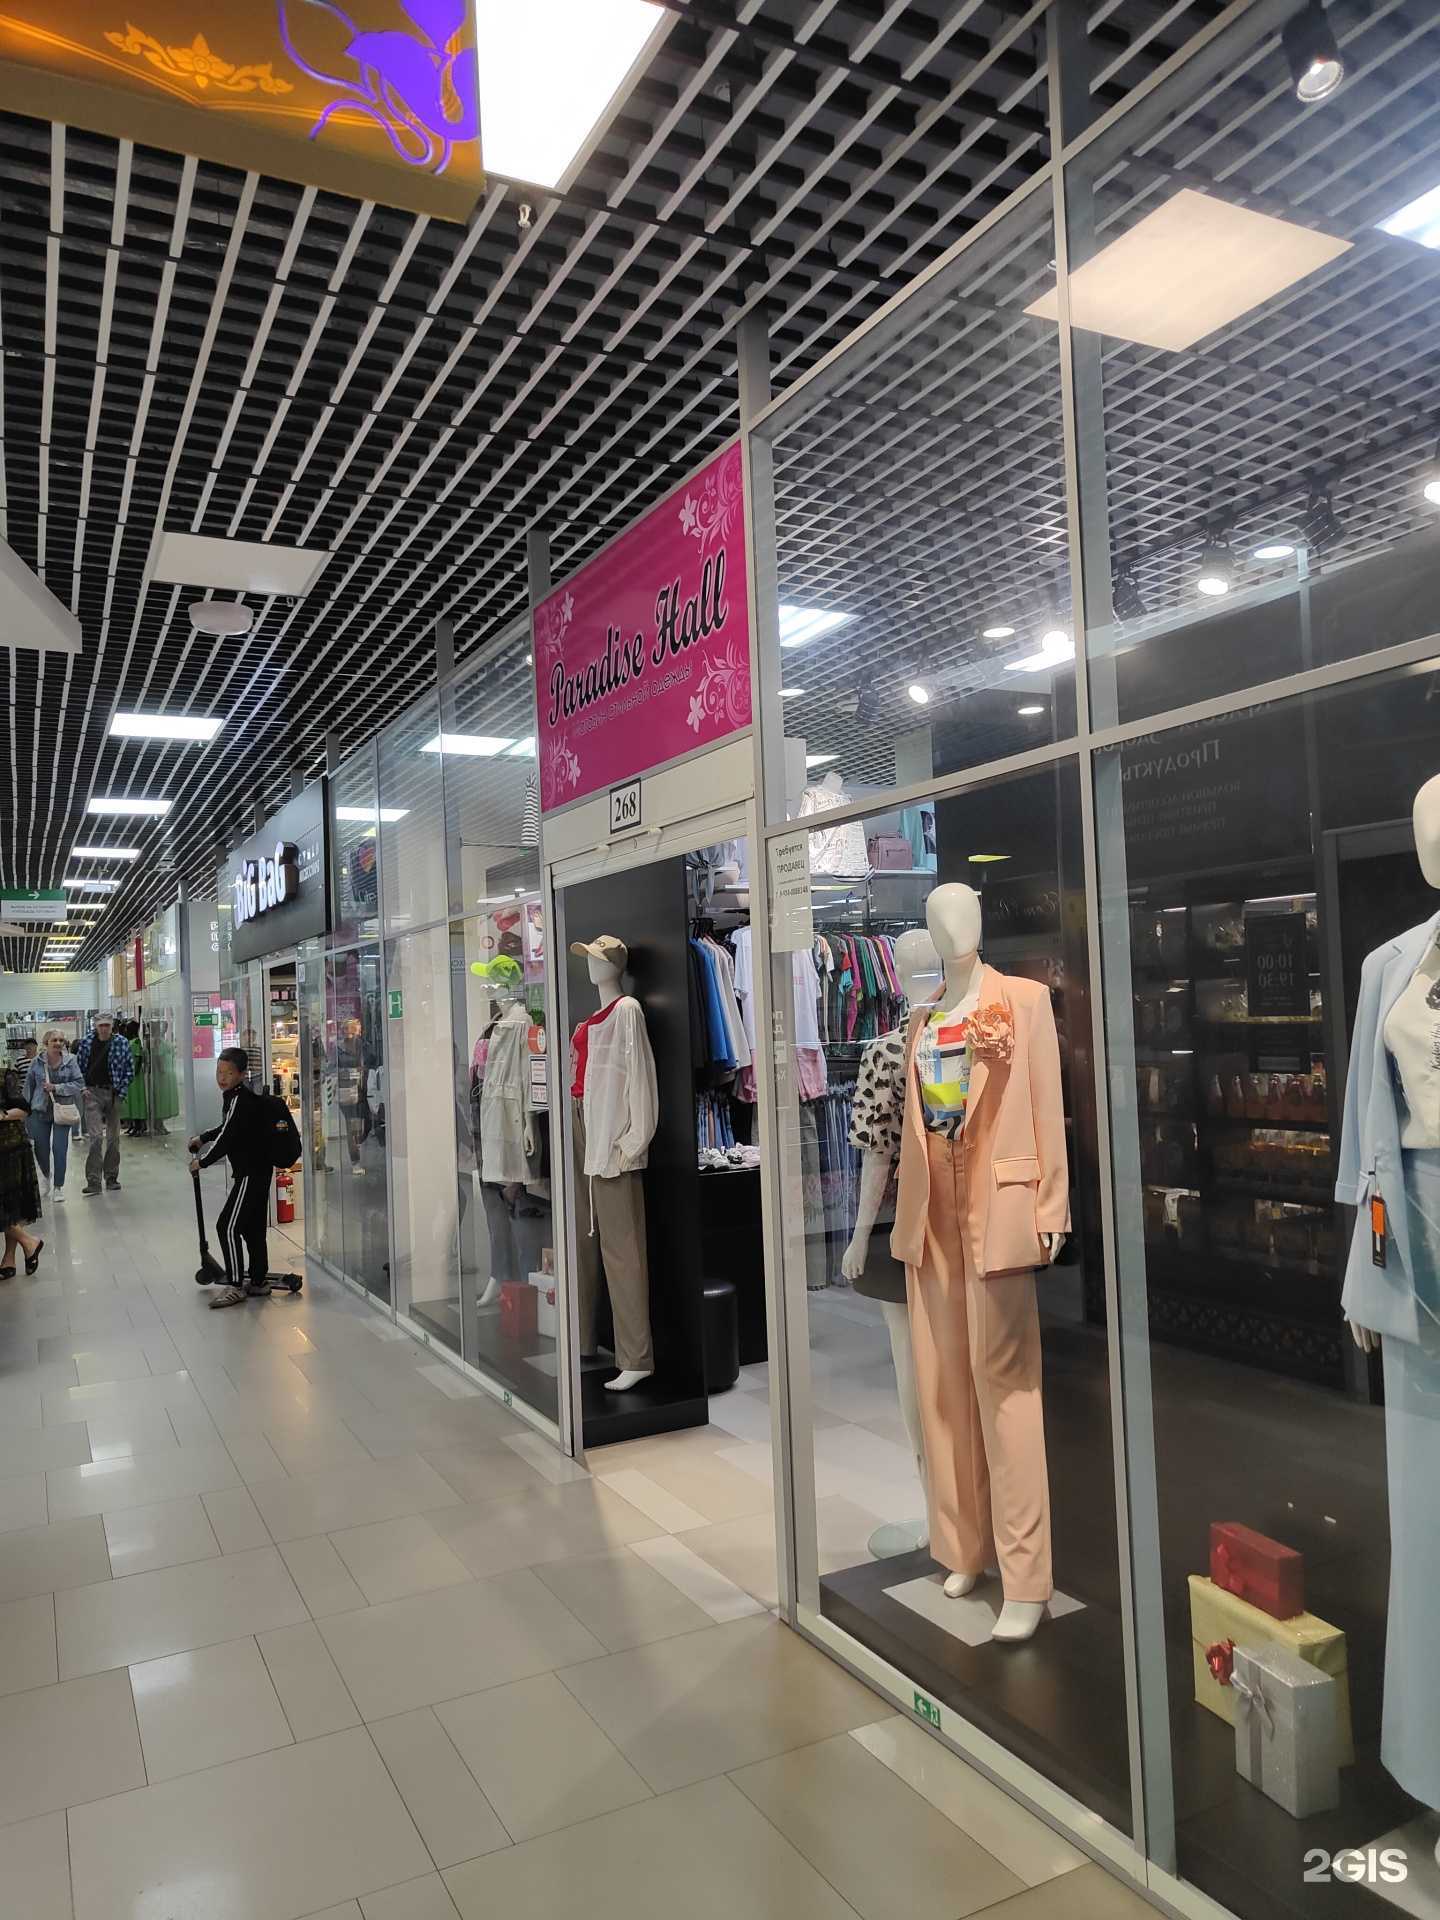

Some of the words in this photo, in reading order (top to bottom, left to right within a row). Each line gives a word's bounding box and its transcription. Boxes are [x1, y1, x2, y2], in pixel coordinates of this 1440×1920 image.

[549, 624, 645, 727] Paradise
[652, 547, 729, 665] Hall
[615, 791, 637, 823] 268
